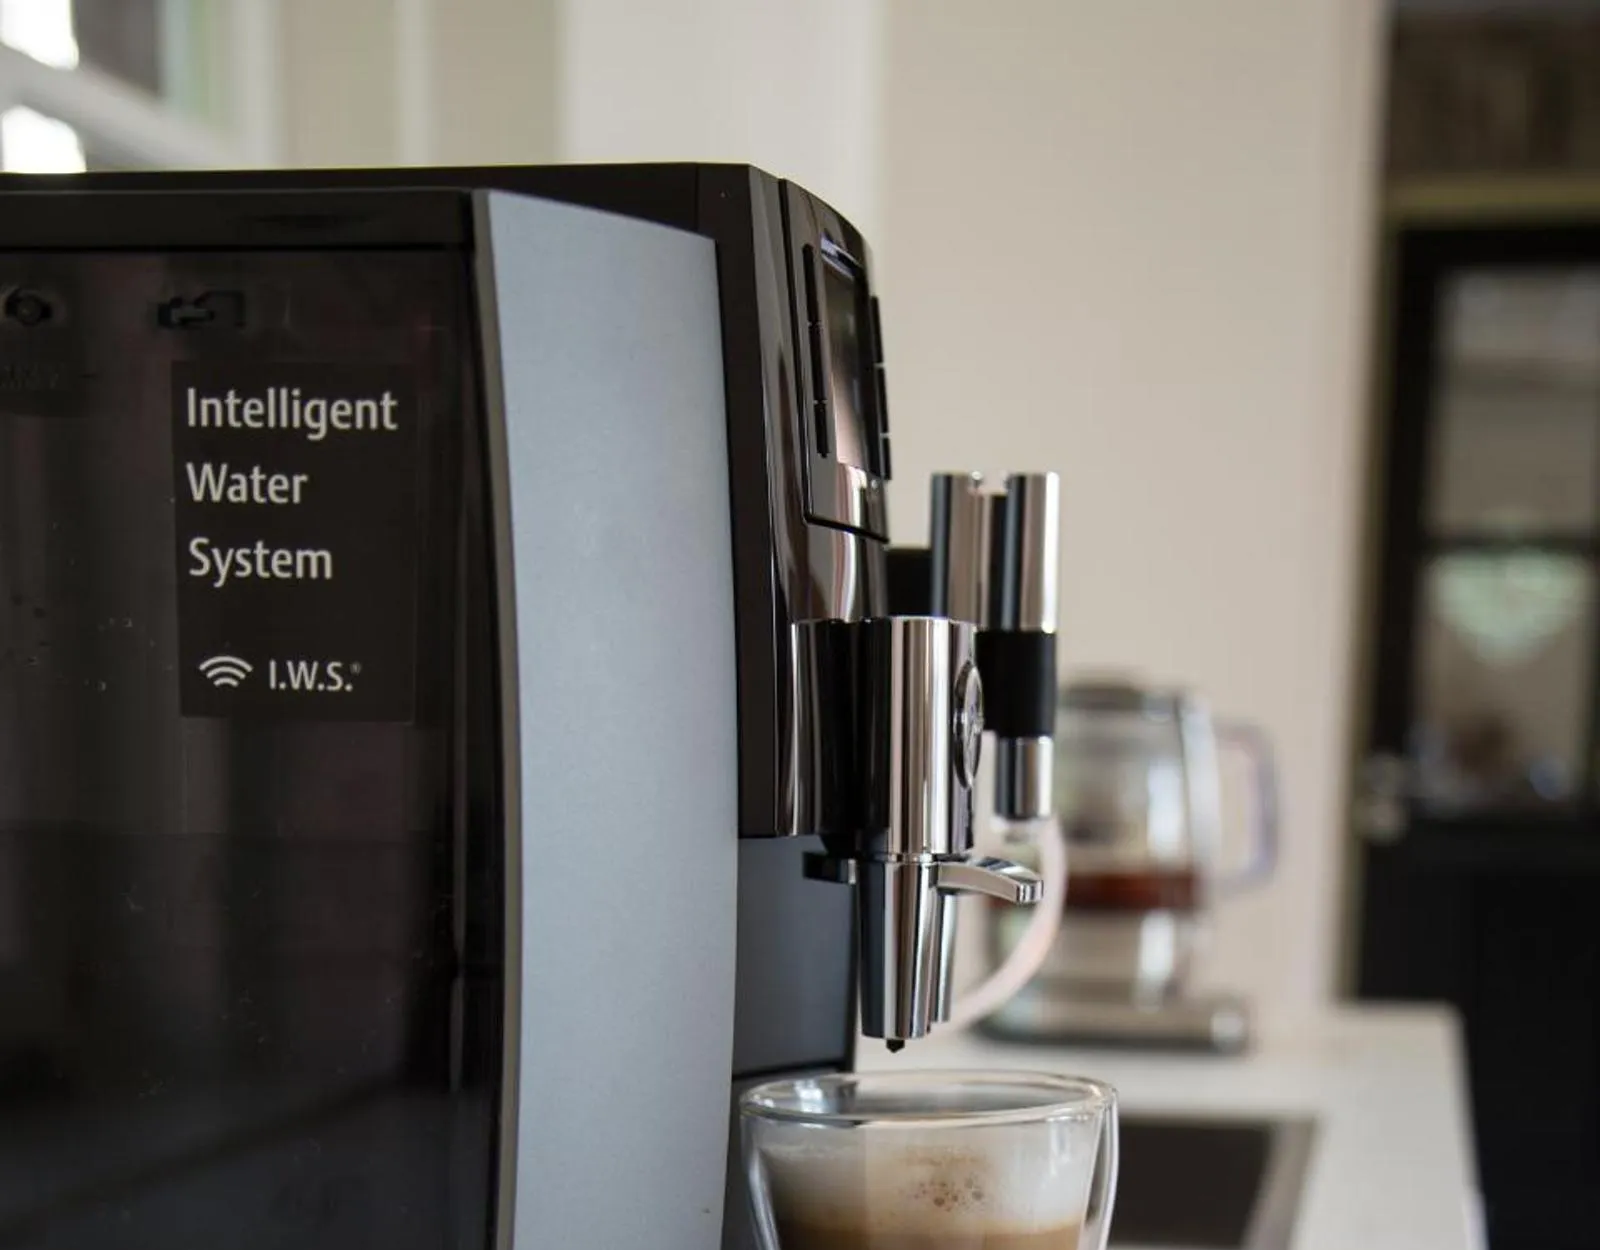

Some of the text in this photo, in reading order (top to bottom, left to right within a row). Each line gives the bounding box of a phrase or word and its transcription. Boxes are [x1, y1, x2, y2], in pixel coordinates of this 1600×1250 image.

[187, 387, 398, 441] Intelligent
[186, 462, 308, 504] Water
[188, 537, 333, 588] System
